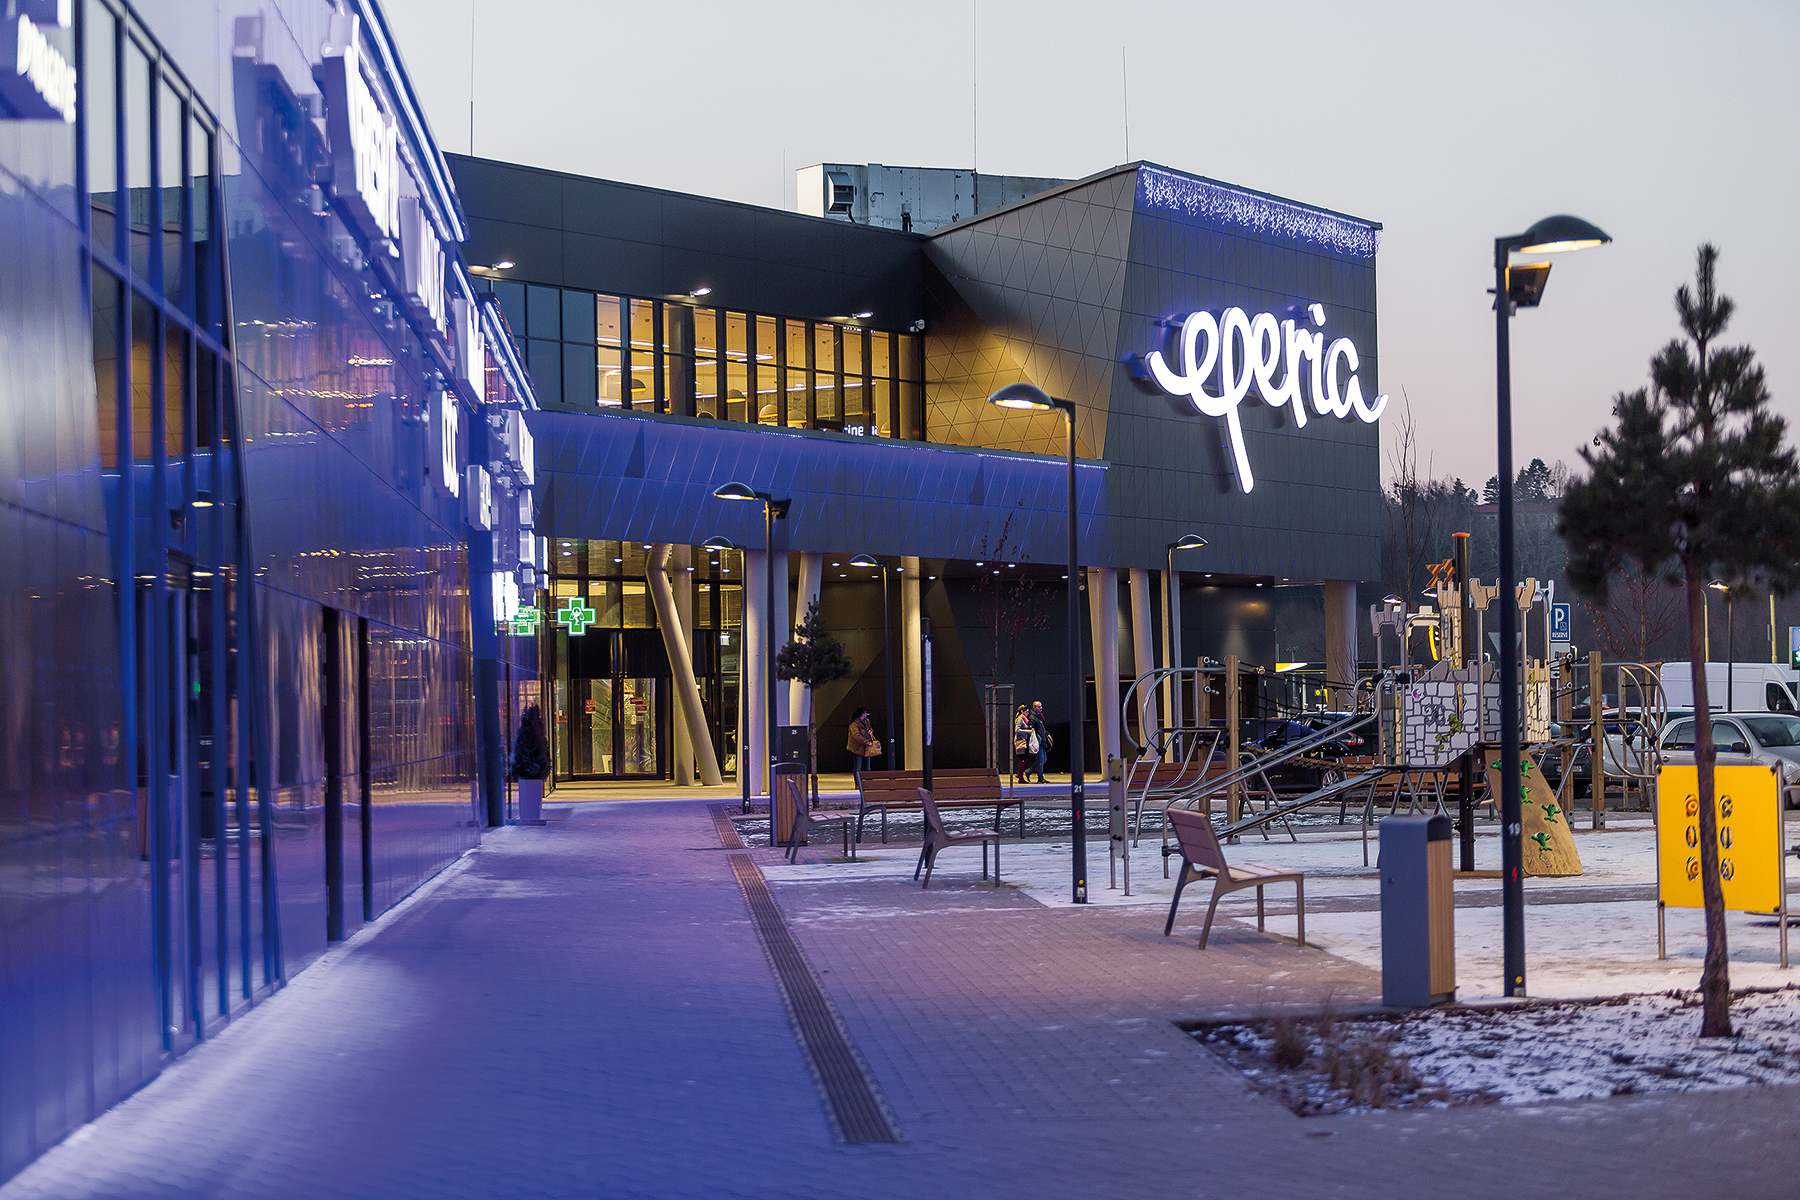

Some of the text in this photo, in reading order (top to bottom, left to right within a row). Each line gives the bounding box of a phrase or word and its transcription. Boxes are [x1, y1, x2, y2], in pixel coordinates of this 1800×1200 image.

[1146, 303, 1389, 494] eperia
[1555, 608, 1565, 629] P
[1508, 822, 1520, 836] 19
